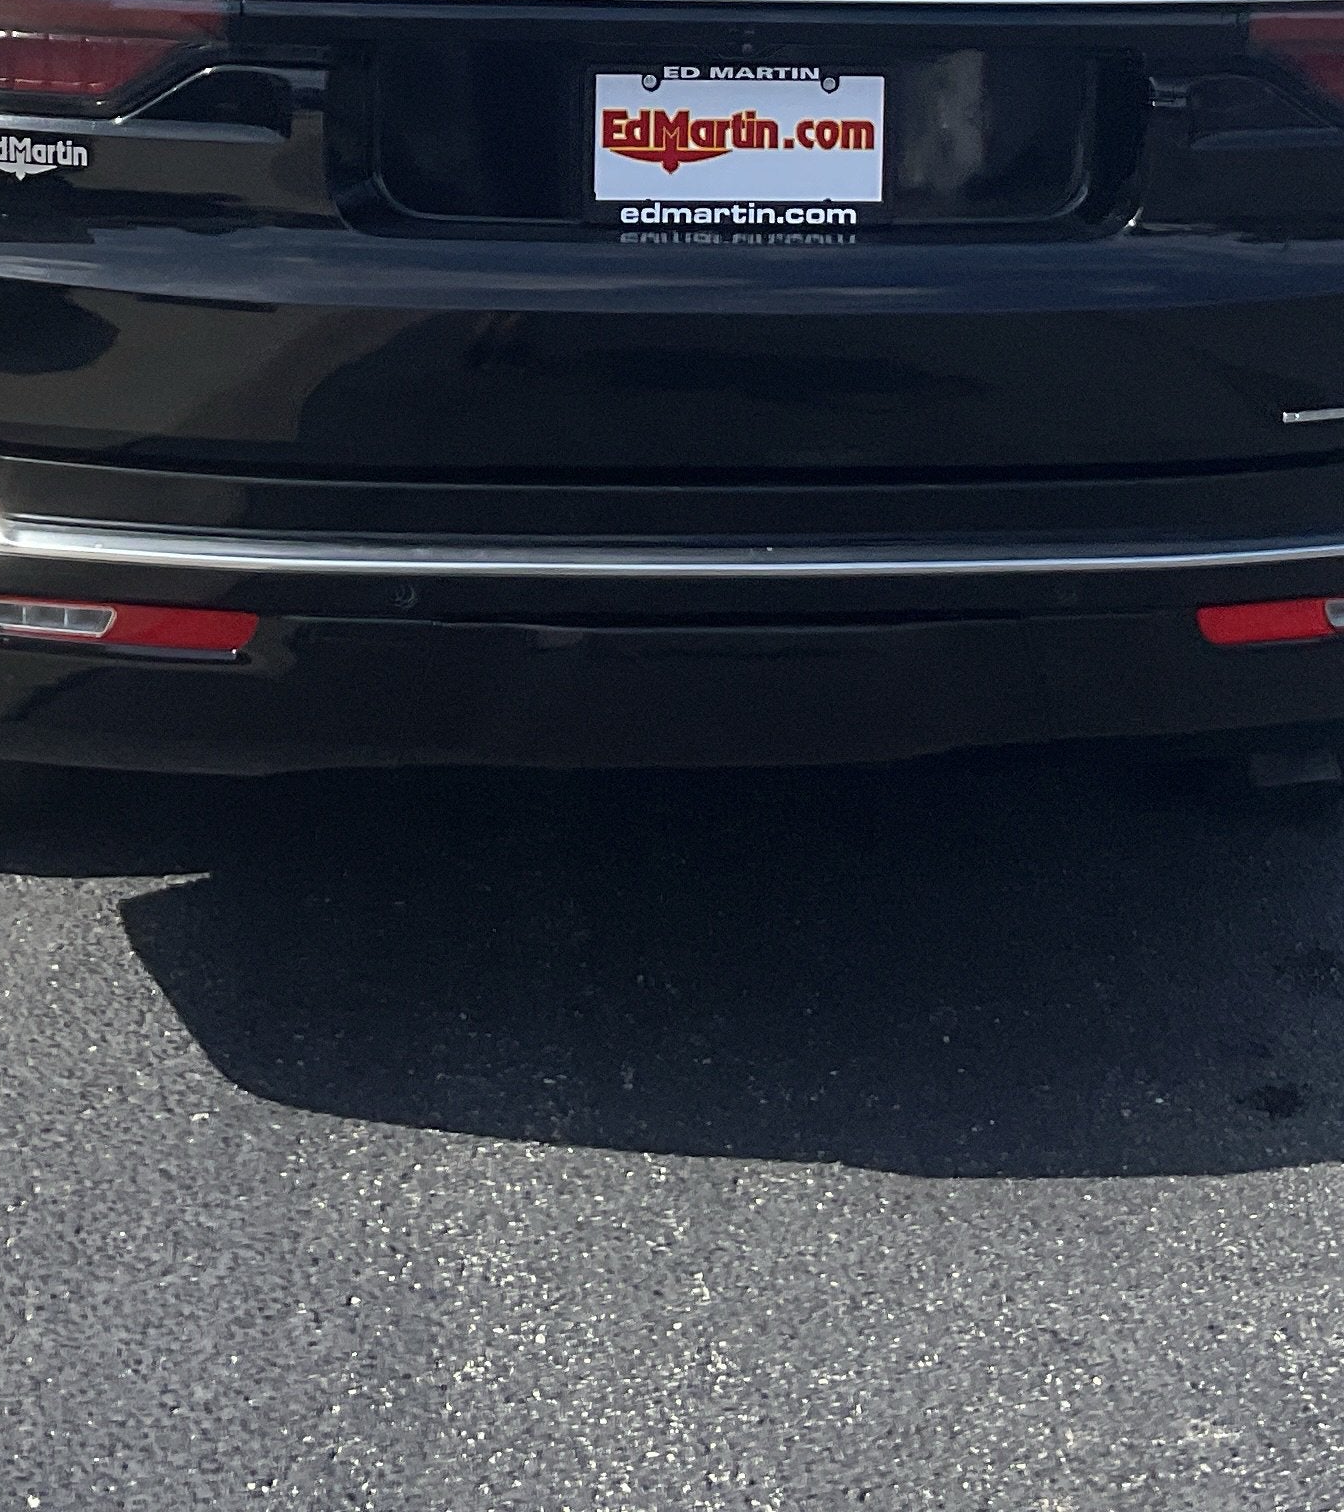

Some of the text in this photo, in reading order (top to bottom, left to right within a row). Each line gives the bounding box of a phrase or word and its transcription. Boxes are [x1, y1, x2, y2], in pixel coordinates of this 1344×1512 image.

[663, 66, 820, 80] ED MARTIN
[601, 108, 875, 150] EdMartin.com
[620, 202, 858, 225] edmartin.com
